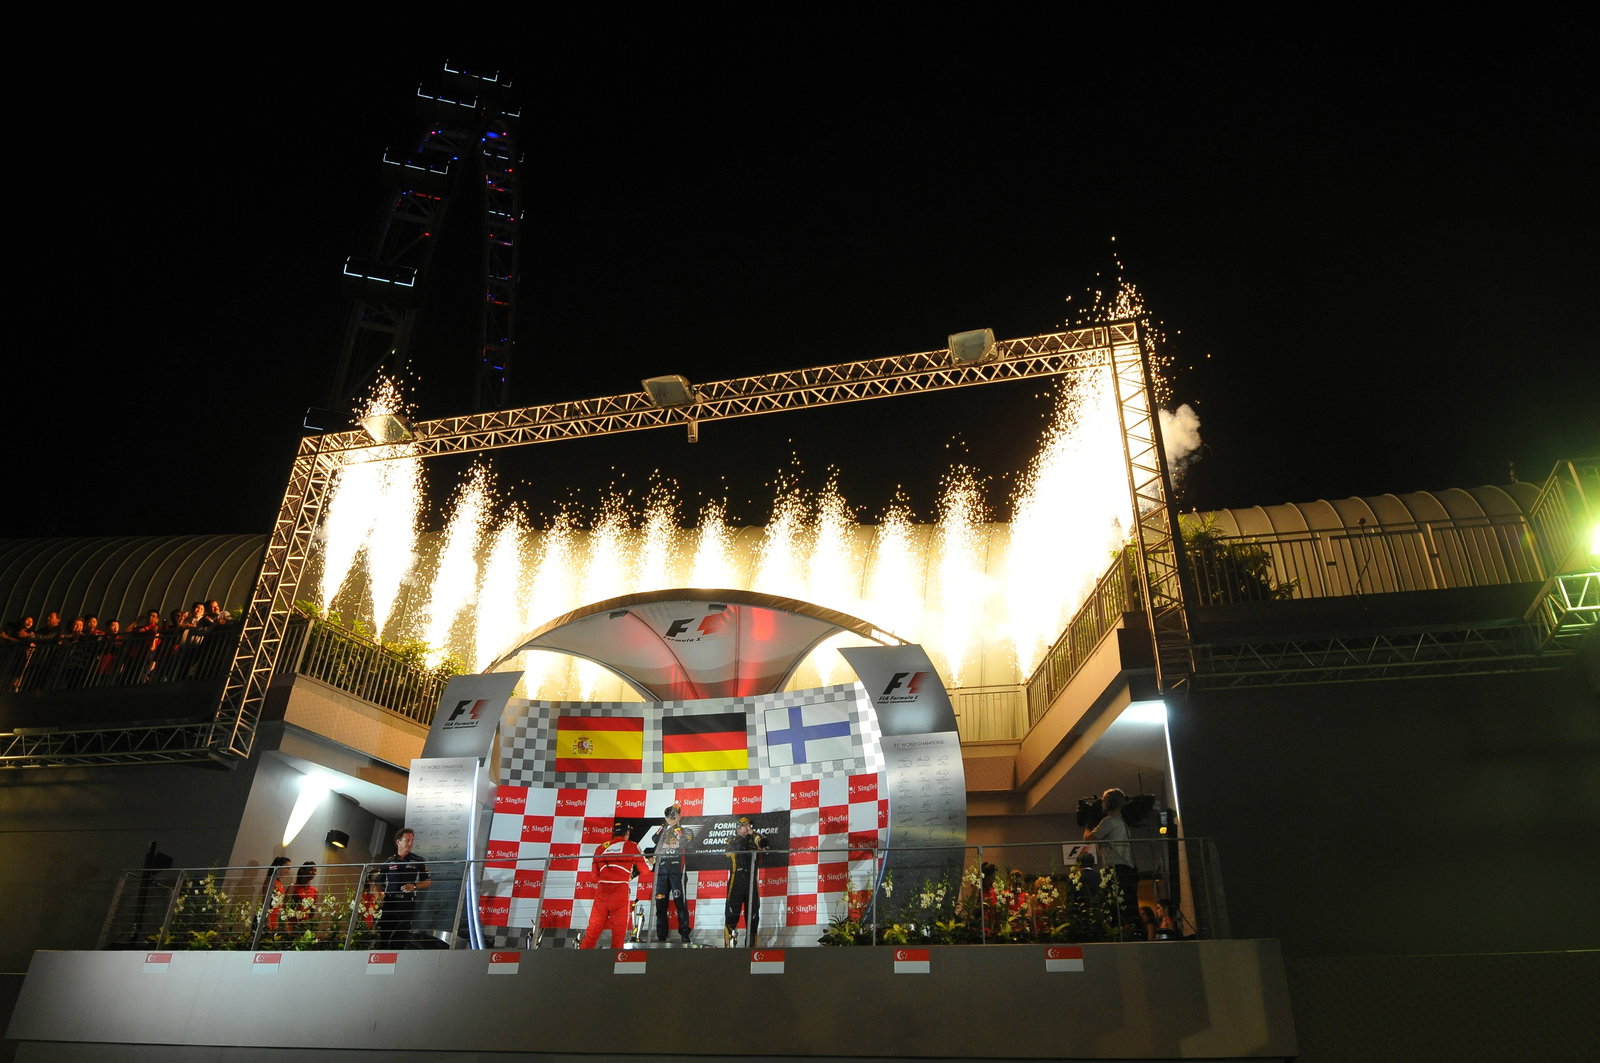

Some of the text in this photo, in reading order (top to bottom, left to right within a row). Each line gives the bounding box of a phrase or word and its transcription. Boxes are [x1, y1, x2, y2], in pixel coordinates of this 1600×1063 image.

[858, 783, 878, 792] SingTel
[799, 790, 819, 799] SingTel
[505, 796, 526, 805] SingTel
[565, 799, 586, 808] SingTel
[625, 800, 645, 808] SingTel
[683, 798, 704, 807] SingTel
[742, 795, 762, 804] SingTel
[828, 814, 848, 824] SingTel
[531, 824, 552, 833] SingTel
[592, 826, 613, 835] SingTel
[496, 850, 518, 859] SingTel
[827, 872, 848, 881] SingTel
[523, 879, 542, 888] SingTe
[706, 880, 728, 889] SingTel
[767, 877, 787, 886] SingTel
[487, 905, 509, 914] SingTel
[796, 904, 817, 913] SingTel
[549, 909, 572, 918] SingTel
